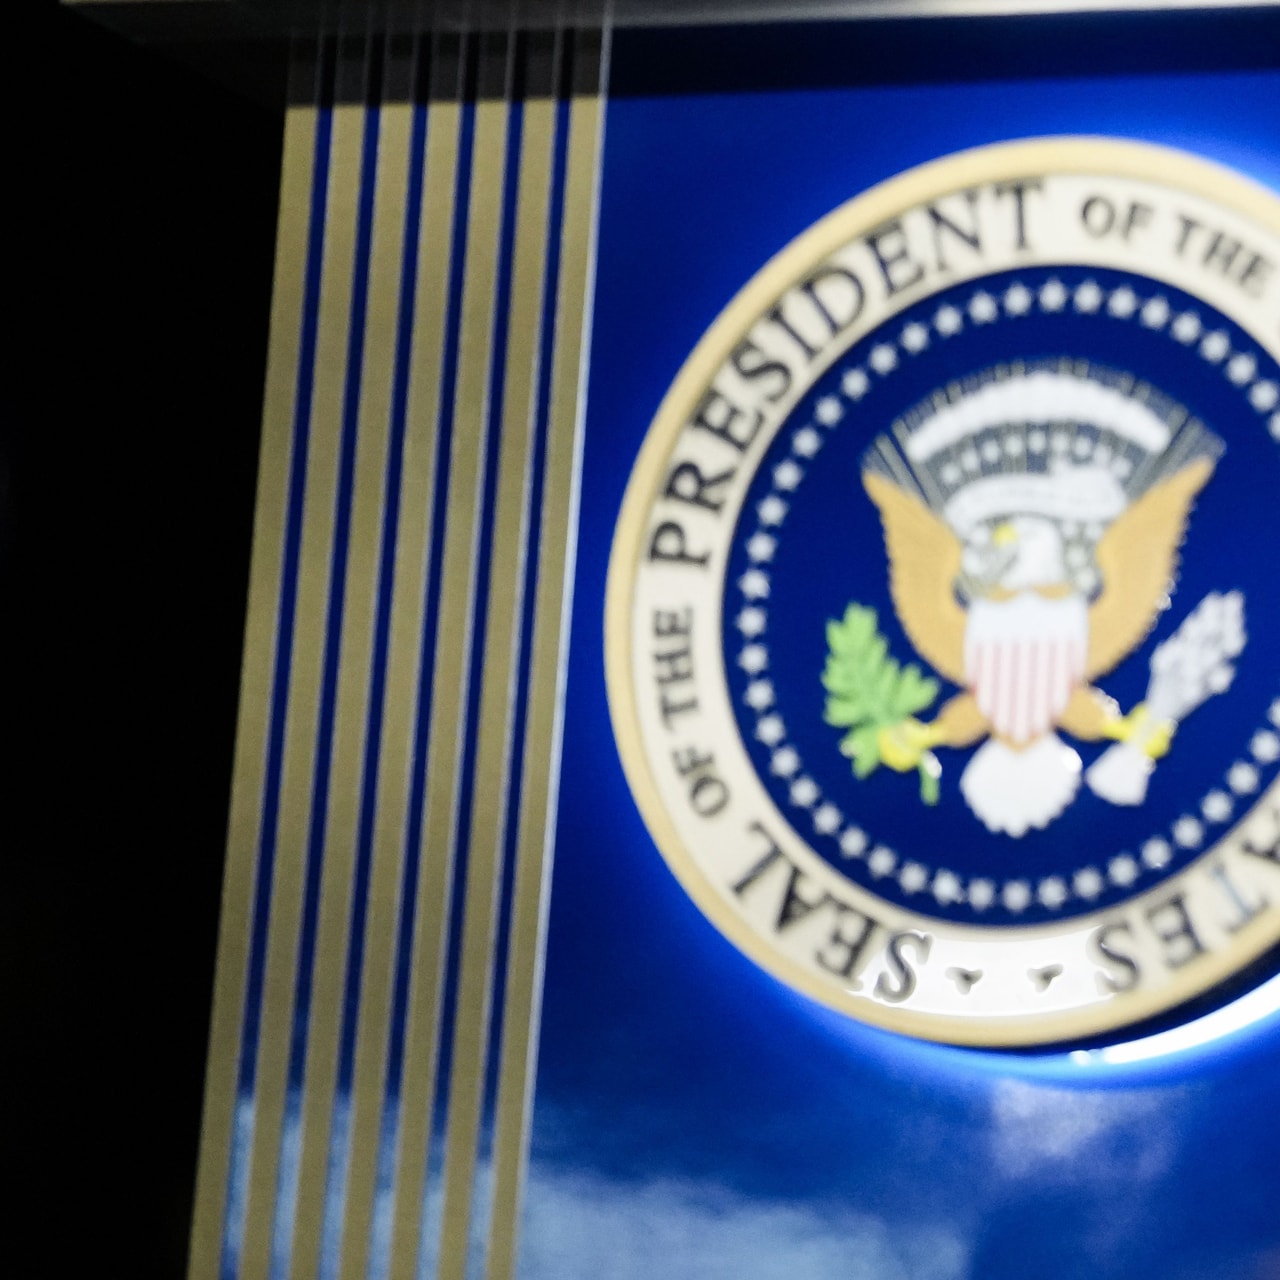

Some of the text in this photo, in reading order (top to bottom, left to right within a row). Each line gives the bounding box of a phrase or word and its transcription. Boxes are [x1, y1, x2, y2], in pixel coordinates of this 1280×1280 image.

[1081, 193, 1154, 243] OF
[1175, 215, 1275, 297] THE
[649, 180, 1046, 573] PRESIDENT
[654, 604, 703, 737] THE
[671, 745, 730, 820] OF
[729, 821, 933, 1002] SEAL
